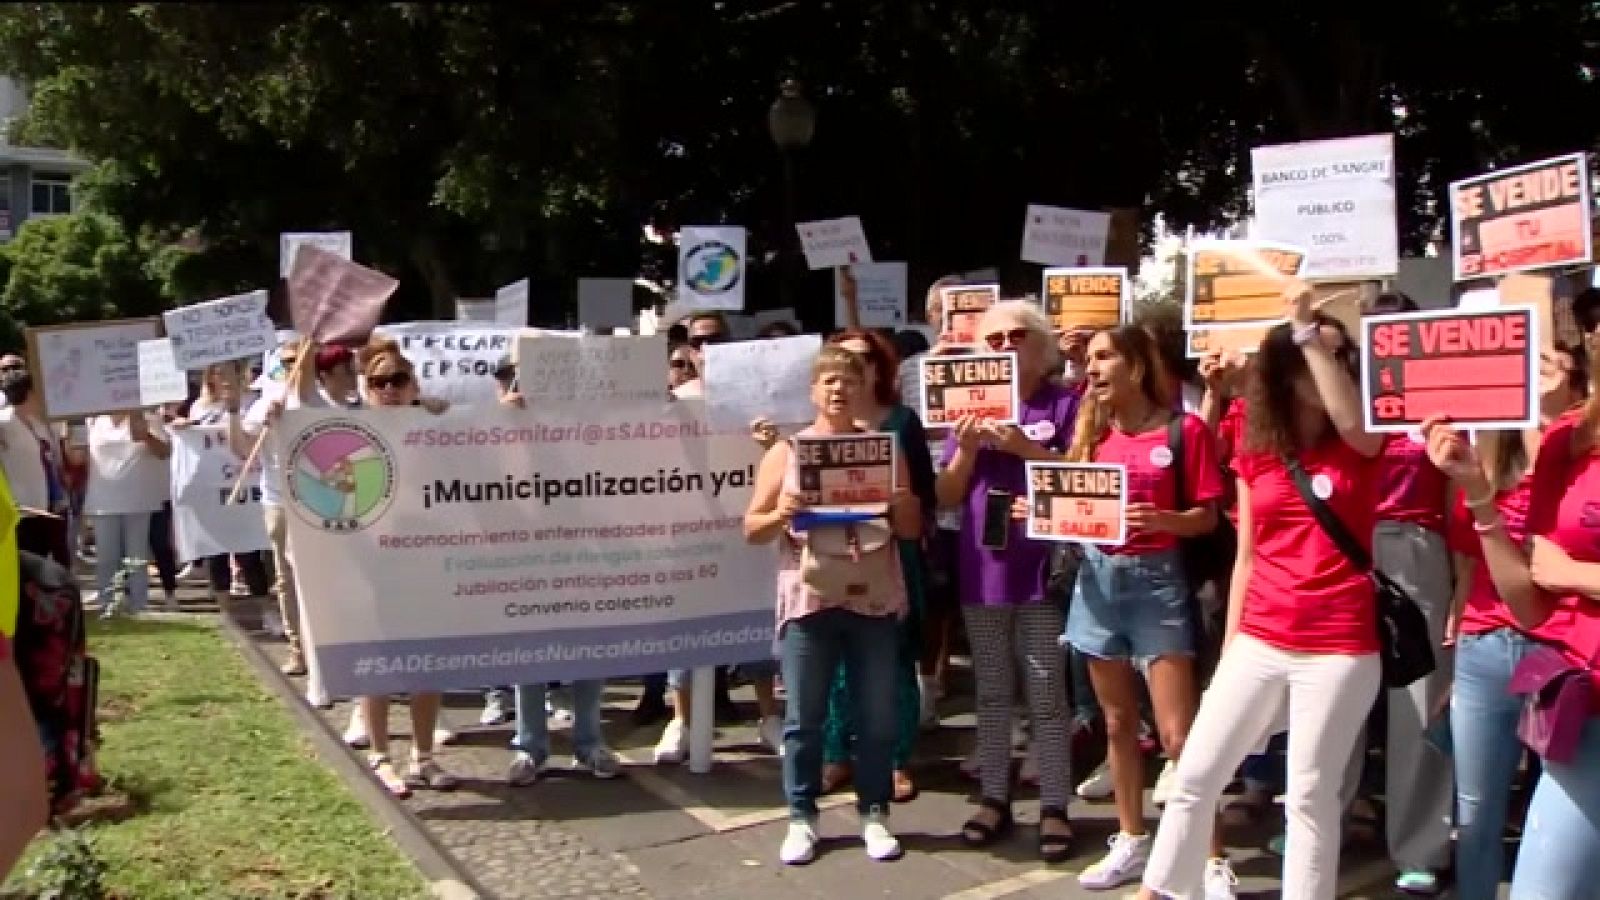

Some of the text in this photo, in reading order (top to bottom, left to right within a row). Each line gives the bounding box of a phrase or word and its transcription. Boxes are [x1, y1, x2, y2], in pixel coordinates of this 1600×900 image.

[1262, 170, 1308, 184] BANCO
[1457, 164, 1580, 220] SE VENDE
[1373, 316, 1526, 358] SE VENDE
[925, 360, 1011, 385] SE VENDE
[968, 389, 985, 401] TU
[799, 439, 891, 465] SE VENDE
[423, 464, 755, 509] ¡Municipalización ya!
[1032, 469, 1054, 492] SE
[1059, 469, 1121, 495] VENDE
[1075, 500, 1094, 516] TU
[379, 526, 529, 548] Reconocimiento
[534, 521, 666, 543] enfermedades
[1060, 520, 1109, 537] SALUD
[453, 577, 548, 597] Jubilación
[552, 571, 651, 592] anticipada
[654, 573, 666, 585] a
[670, 567, 693, 582] las
[504, 592, 674, 618] Convenio colectivo
